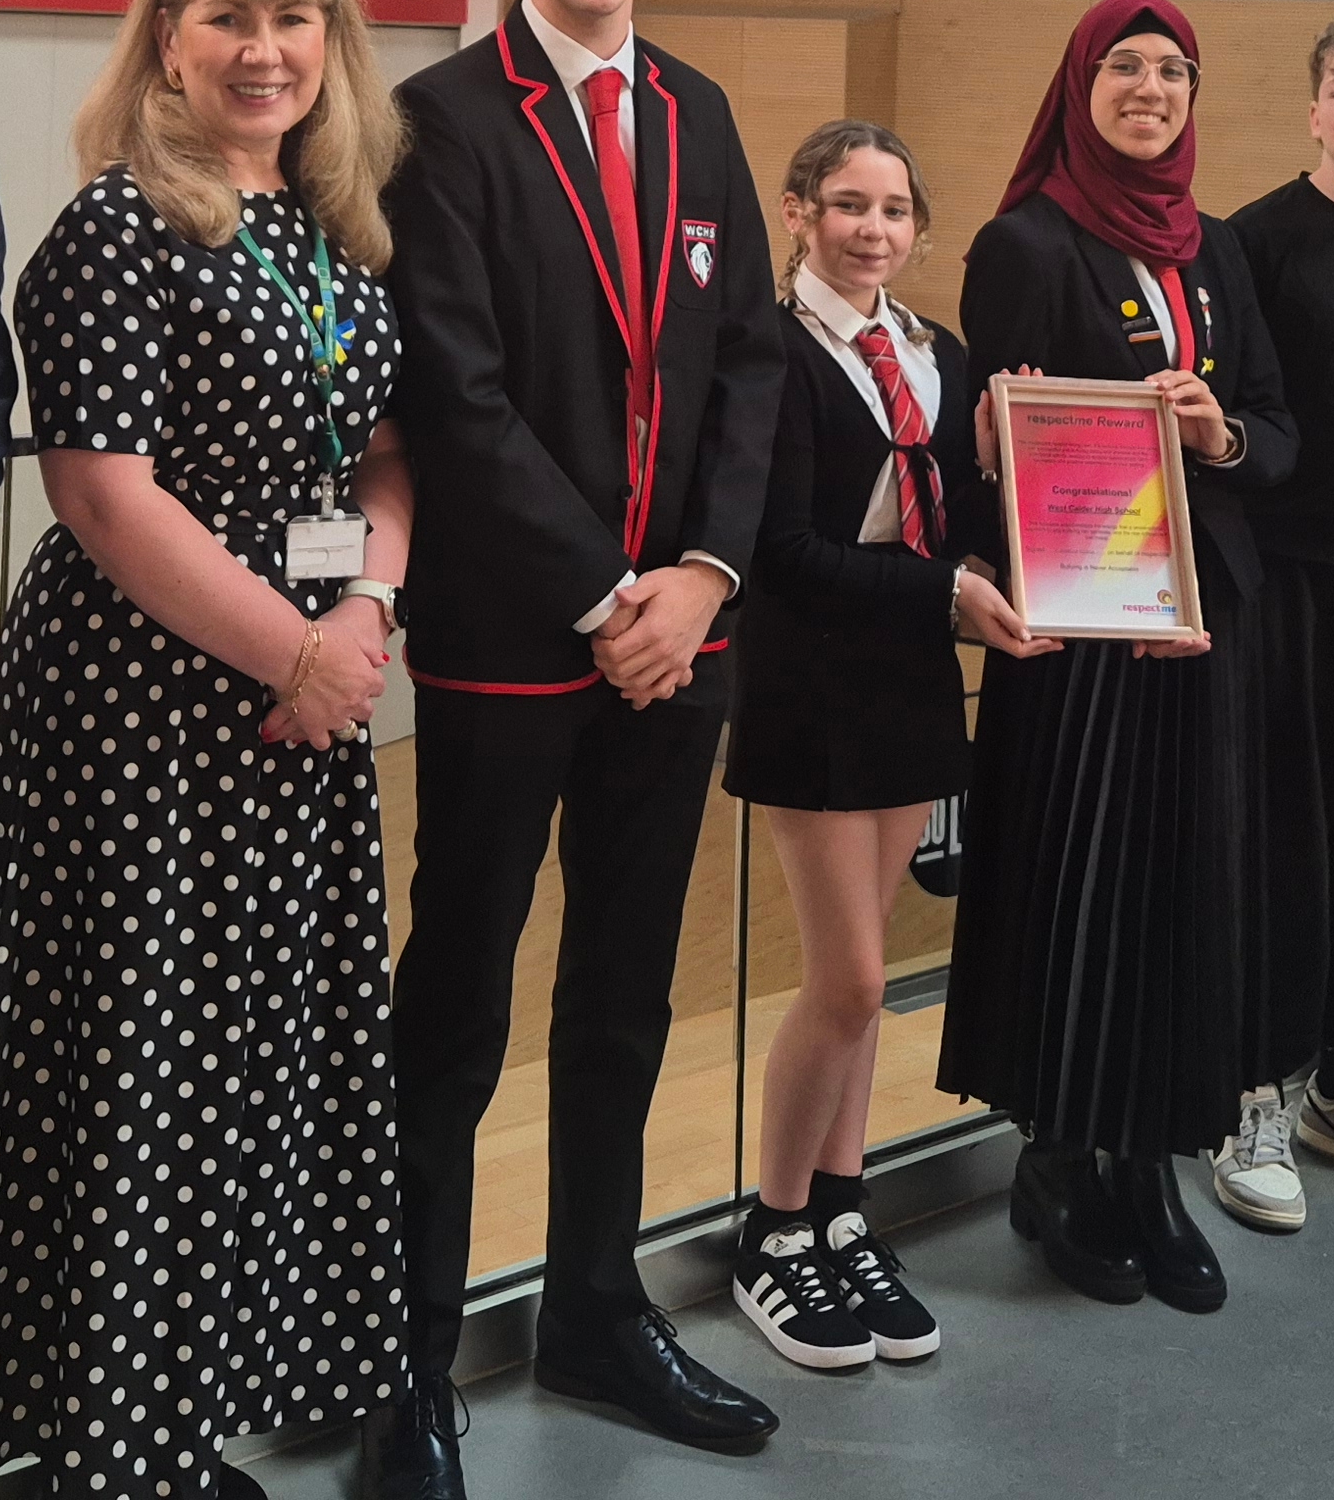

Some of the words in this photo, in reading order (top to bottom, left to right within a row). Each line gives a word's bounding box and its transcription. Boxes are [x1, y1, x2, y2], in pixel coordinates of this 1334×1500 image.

[685, 224, 716, 239] WCHS
[1027, 414, 1093, 427] respectme
[1097, 416, 1145, 429] Reward
[1052, 485, 1132, 497] Congratulations!
